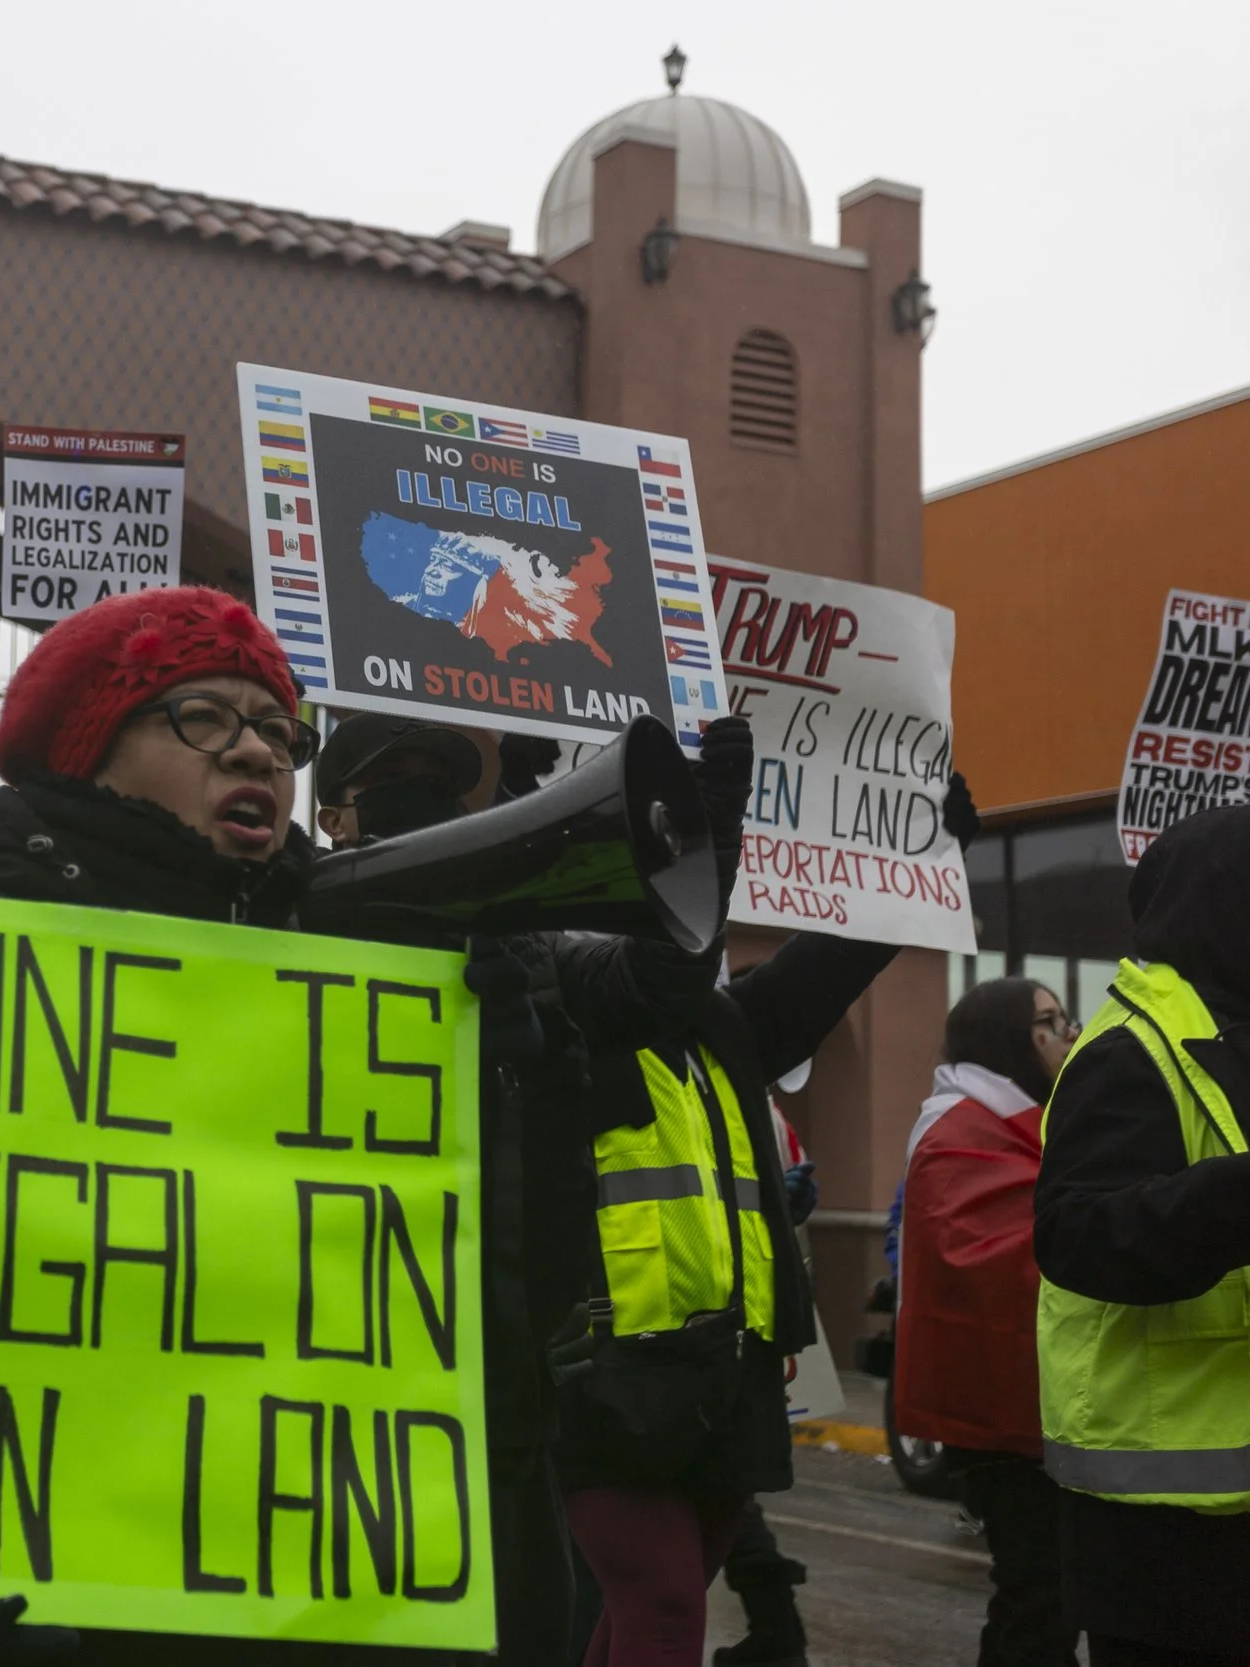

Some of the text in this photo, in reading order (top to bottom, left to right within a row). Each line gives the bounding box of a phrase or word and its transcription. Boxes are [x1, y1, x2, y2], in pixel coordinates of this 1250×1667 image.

[8, 432, 155, 453] STAND WITH PALESTINE
[425, 444, 556, 483] NO ONE IS
[12, 480, 172, 515] IMMIGRANT
[396, 468, 582, 532] ILLEGAL
[11, 545, 168, 575] LEGALIZATION
[12, 515, 169, 548] RIGHTS AND
[10, 573, 78, 610] FOR
[1170, 596, 1246, 627] FIGHT
[363, 655, 413, 691] ON
[423, 664, 554, 713] STOLEN
[1141, 654, 1250, 738] DREA
[781, 695, 831, 758] IS
[842, 708, 954, 786] ILLEGA
[831, 774, 939, 856] LAND
[739, 833, 962, 911] EPORTATIONS
[749, 881, 848, 925] RAIDS
[274, 969, 444, 1156] IS
[295, 1179, 459, 1372] ON
[181, 1393, 471, 1603] LAND
